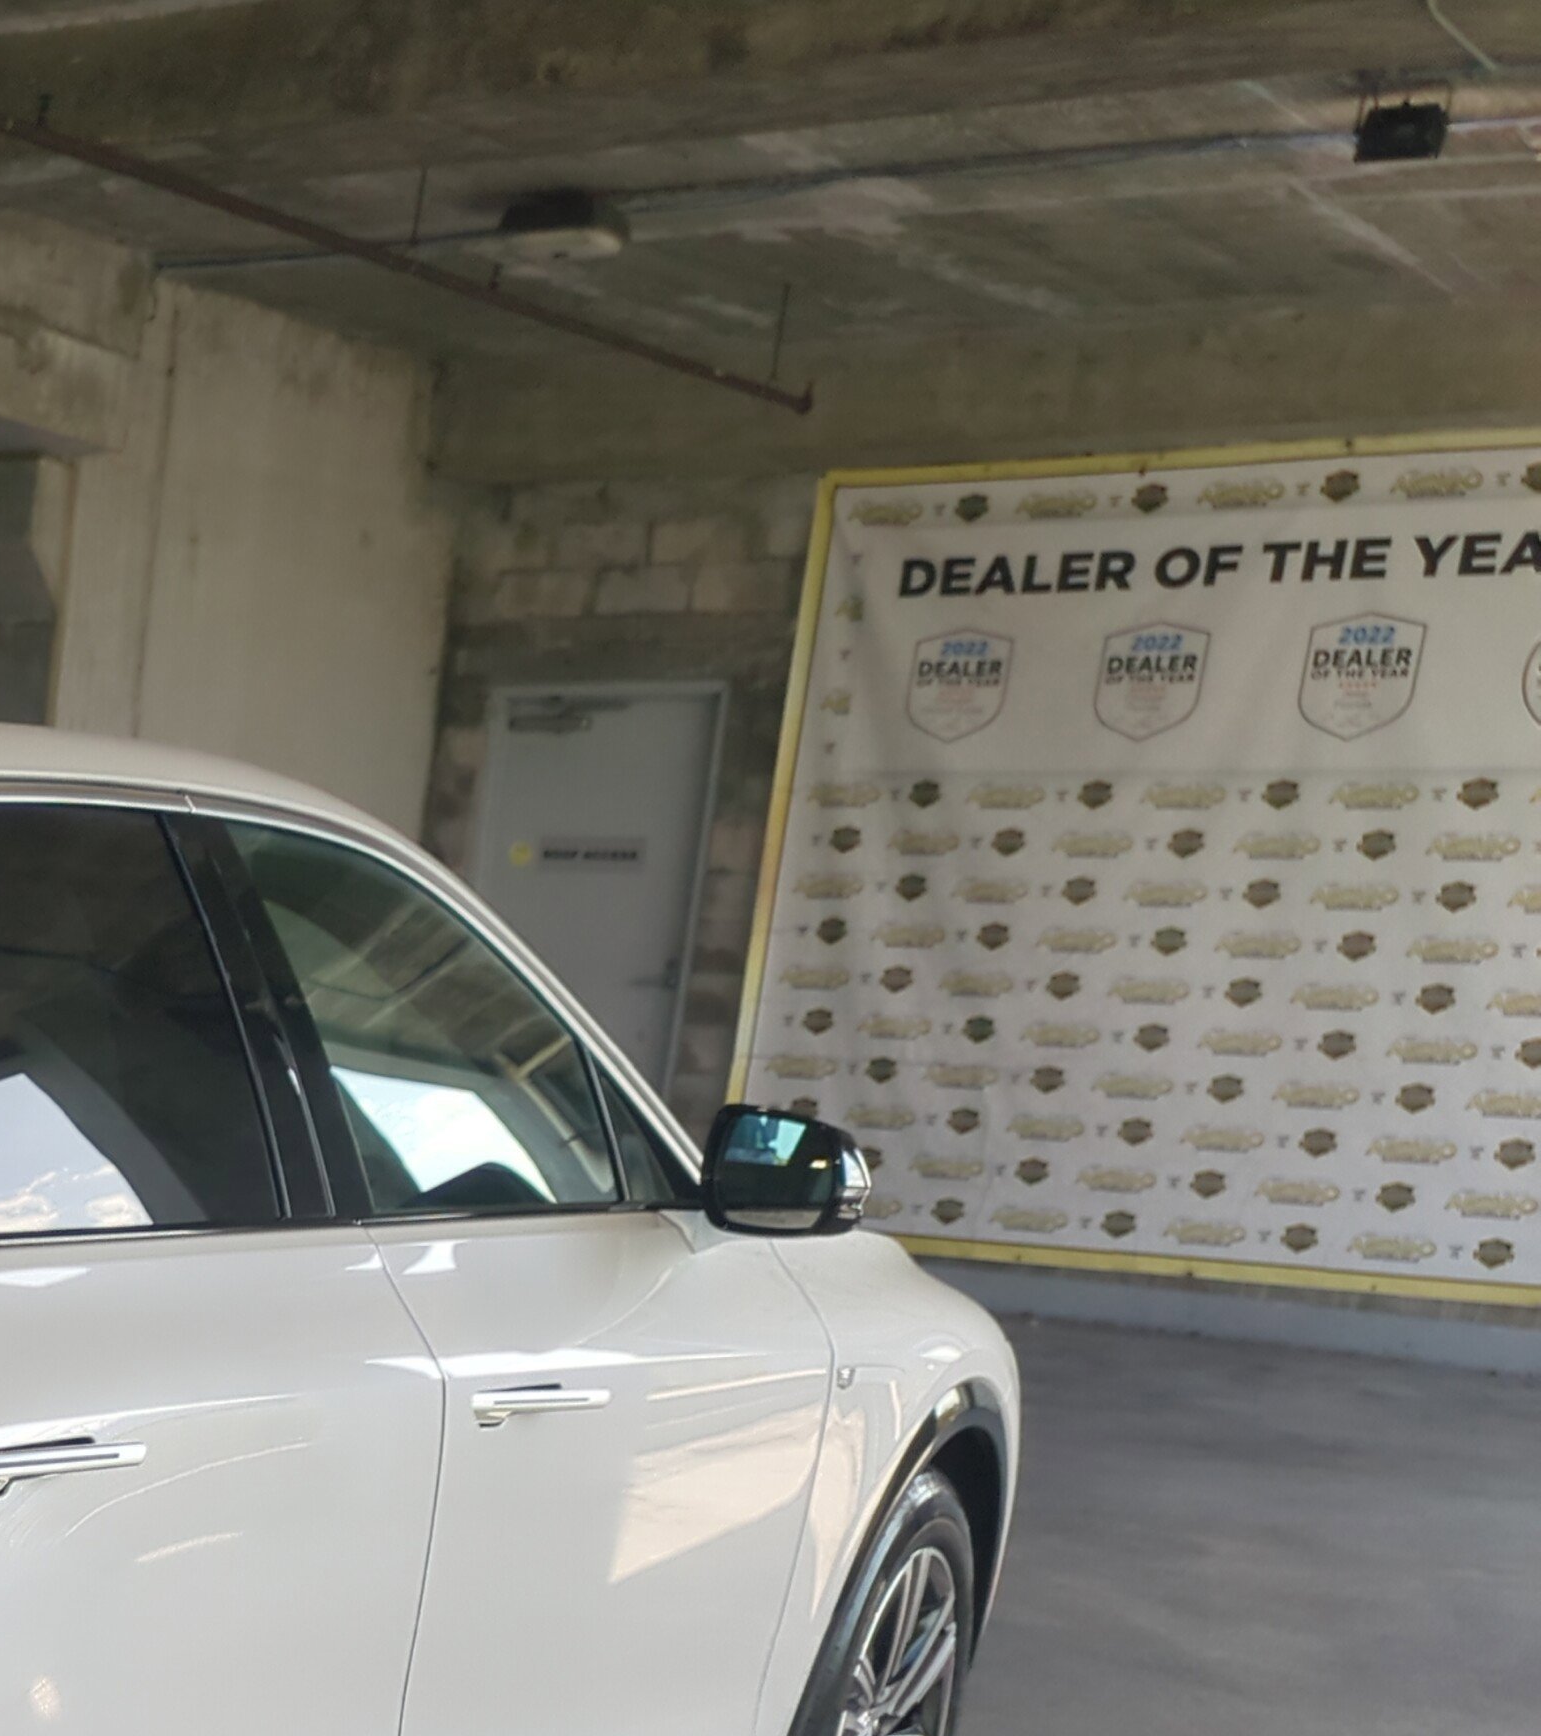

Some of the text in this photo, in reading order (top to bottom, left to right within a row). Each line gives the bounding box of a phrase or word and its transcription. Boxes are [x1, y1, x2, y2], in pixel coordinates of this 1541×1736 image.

[898, 550, 1138, 598] DEALER
[1154, 544, 1245, 589] OF
[1262, 537, 1393, 583] THE
[1337, 625, 1396, 645] 2022
[917, 658, 1004, 678] DEALER
[1106, 653, 1199, 675] DEALER
[1312, 647, 1413, 669] DEALER
